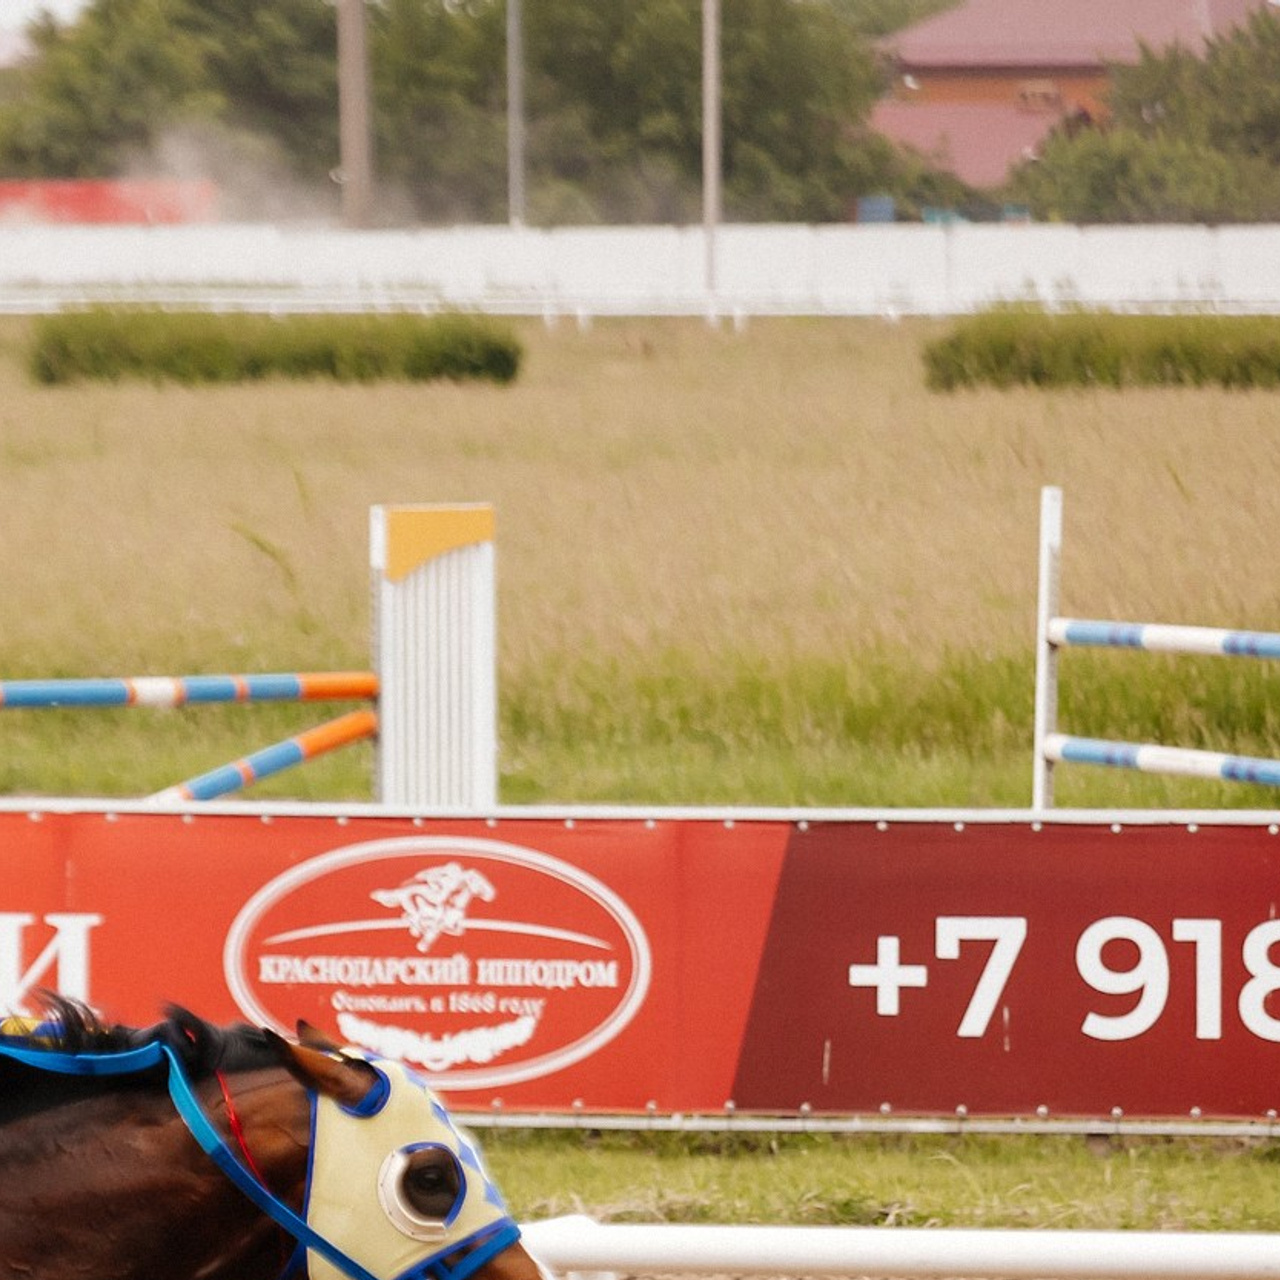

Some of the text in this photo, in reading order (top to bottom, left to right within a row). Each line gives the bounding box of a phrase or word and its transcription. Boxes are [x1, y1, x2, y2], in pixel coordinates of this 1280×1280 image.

[259, 954, 618, 990] КРАСНОДАРСКИЙ ИППОДРОМ
[848, 915, 1028, 1038] +7
